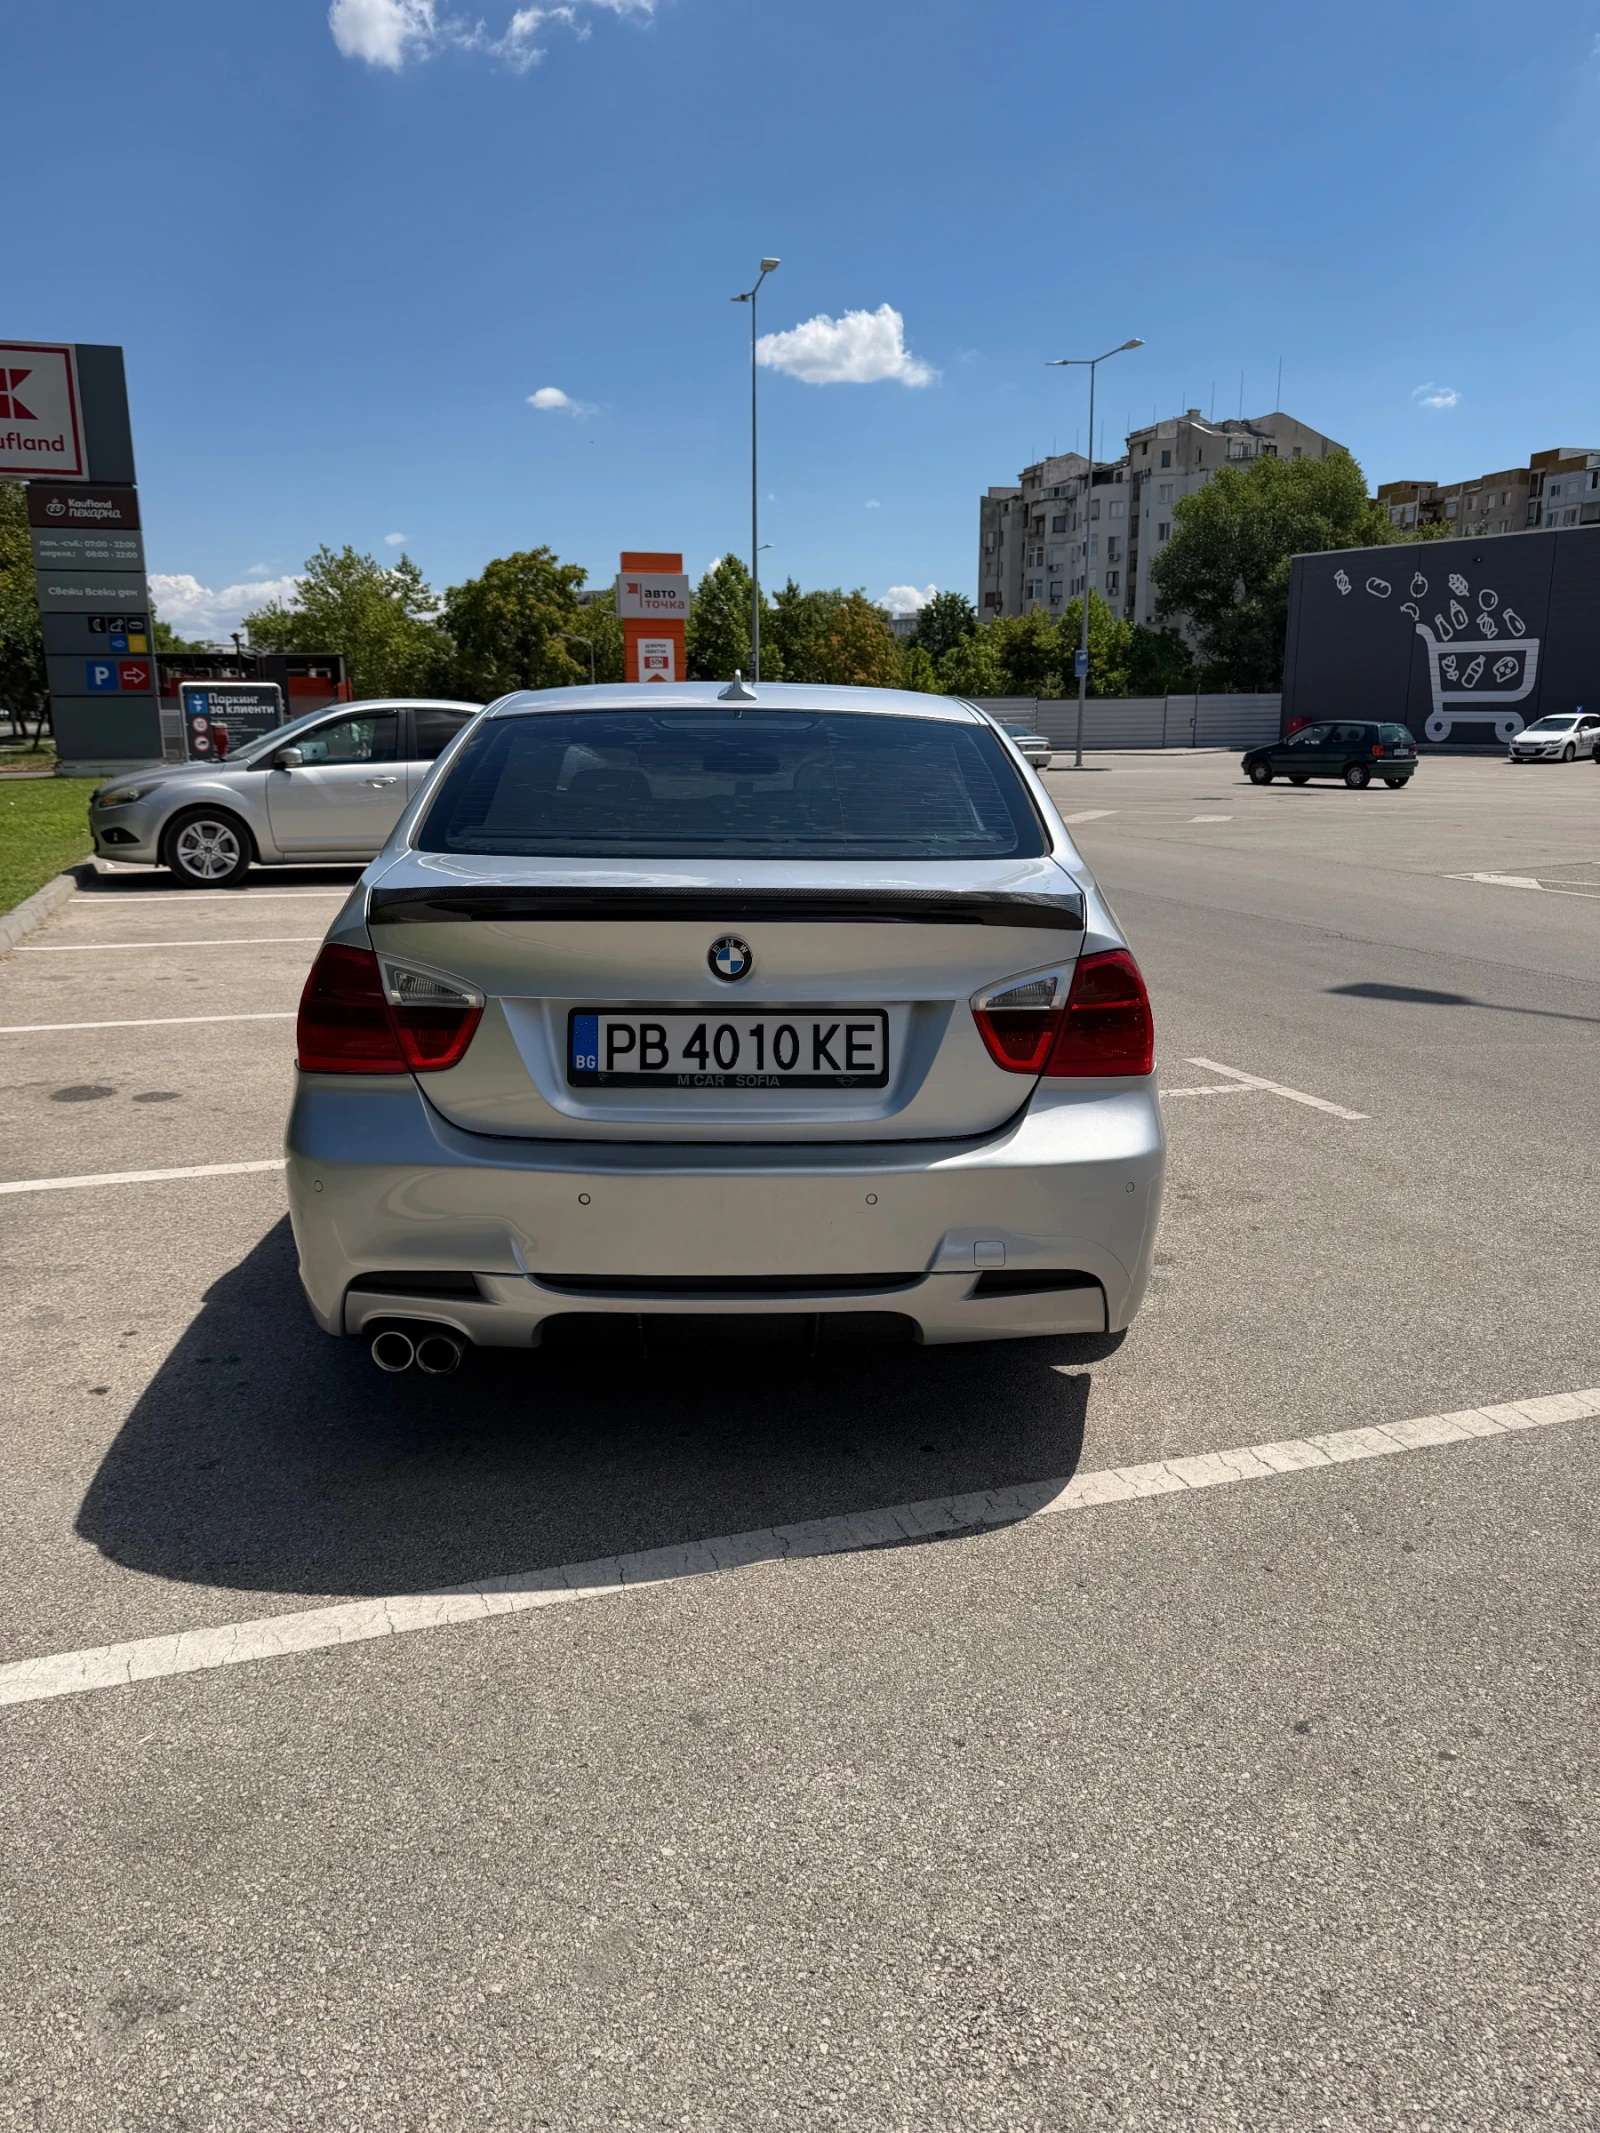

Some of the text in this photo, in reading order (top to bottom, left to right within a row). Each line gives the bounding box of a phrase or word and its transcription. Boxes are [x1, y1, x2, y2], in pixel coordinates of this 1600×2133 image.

[68, 499, 112, 509] Kaufland
[68, 508, 122, 520] пекарна
[117, 588, 138, 598] ден
[644, 590, 676, 598] авто
[645, 600, 685, 610] точка
[94, 666, 110, 685] P
[208, 693, 259, 706] Паркинг
[209, 705, 275, 714] за клиенти
[711, 939, 749, 954] BMW
[606, 1023, 876, 1071] PB 4010 KE
[575, 1055, 596, 1069] BG
[677, 1074, 781, 1087] M CAR SOFIA
